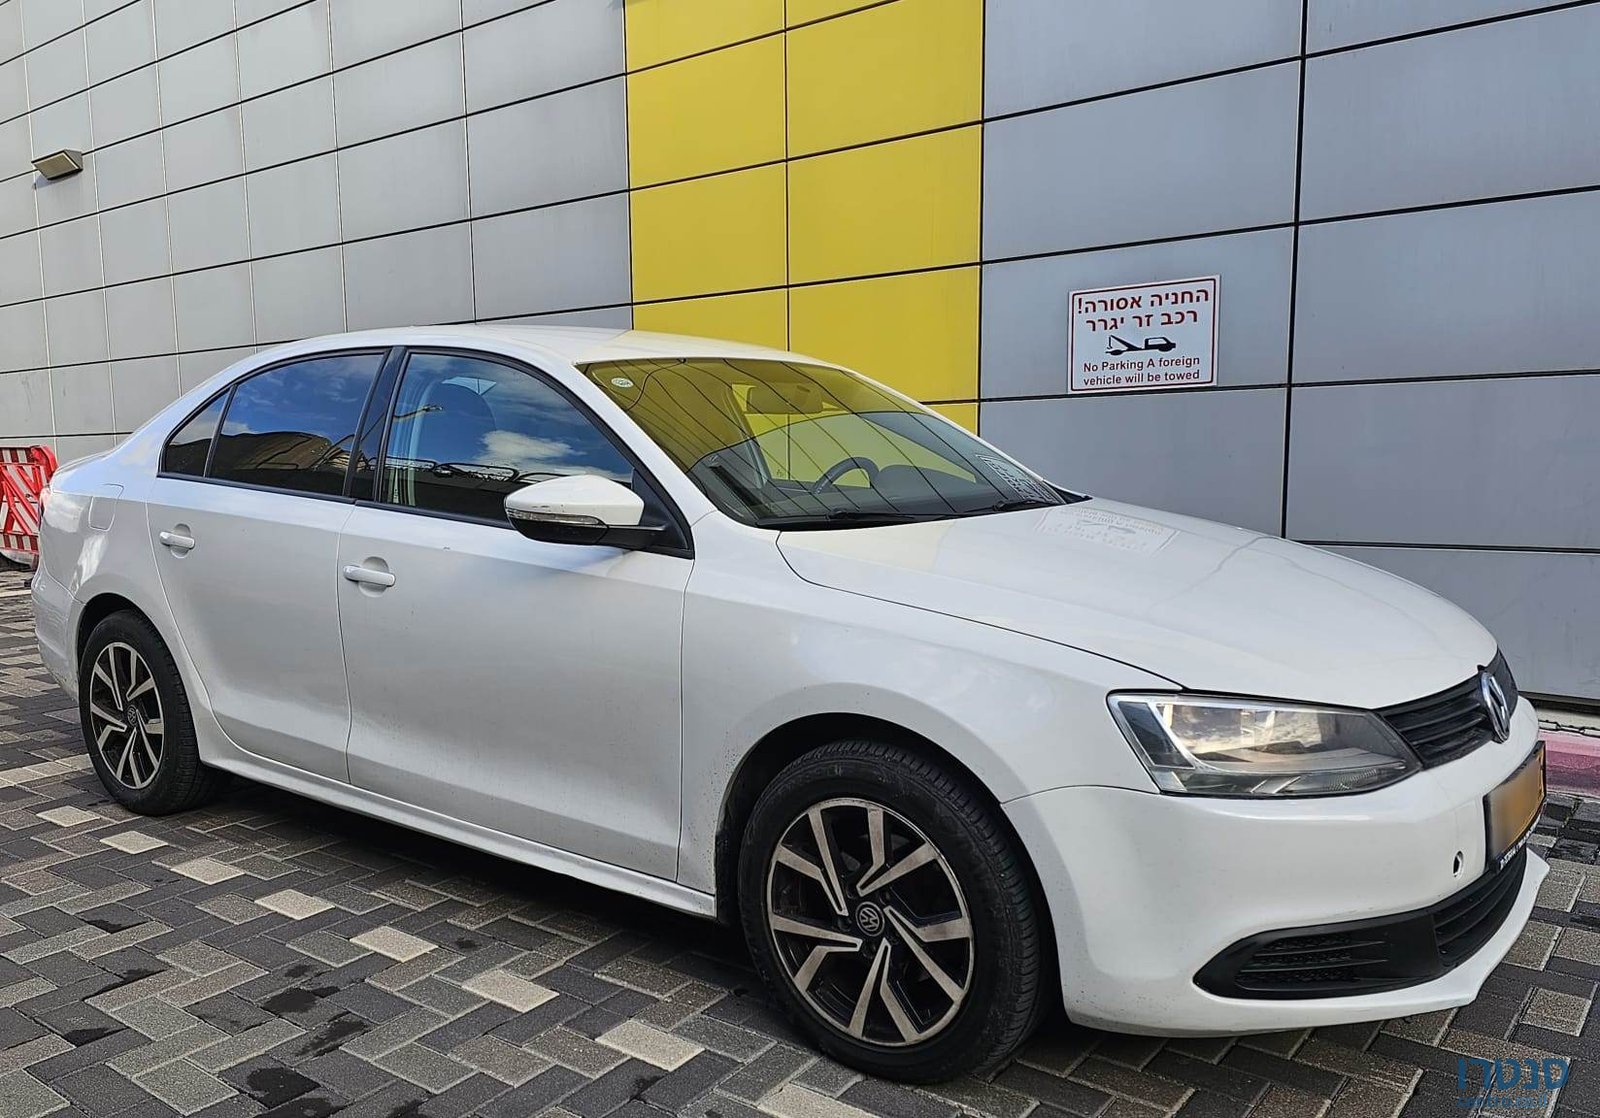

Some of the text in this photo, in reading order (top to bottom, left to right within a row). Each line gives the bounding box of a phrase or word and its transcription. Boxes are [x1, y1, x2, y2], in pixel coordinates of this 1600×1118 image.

[1077, 289, 1209, 314] החניה אסורה!
[1086, 310, 1198, 332] רכב זר יגרר
[1083, 356, 1200, 373] No Parking A foreign
[1083, 369, 1200, 386] vehicle will be towed
